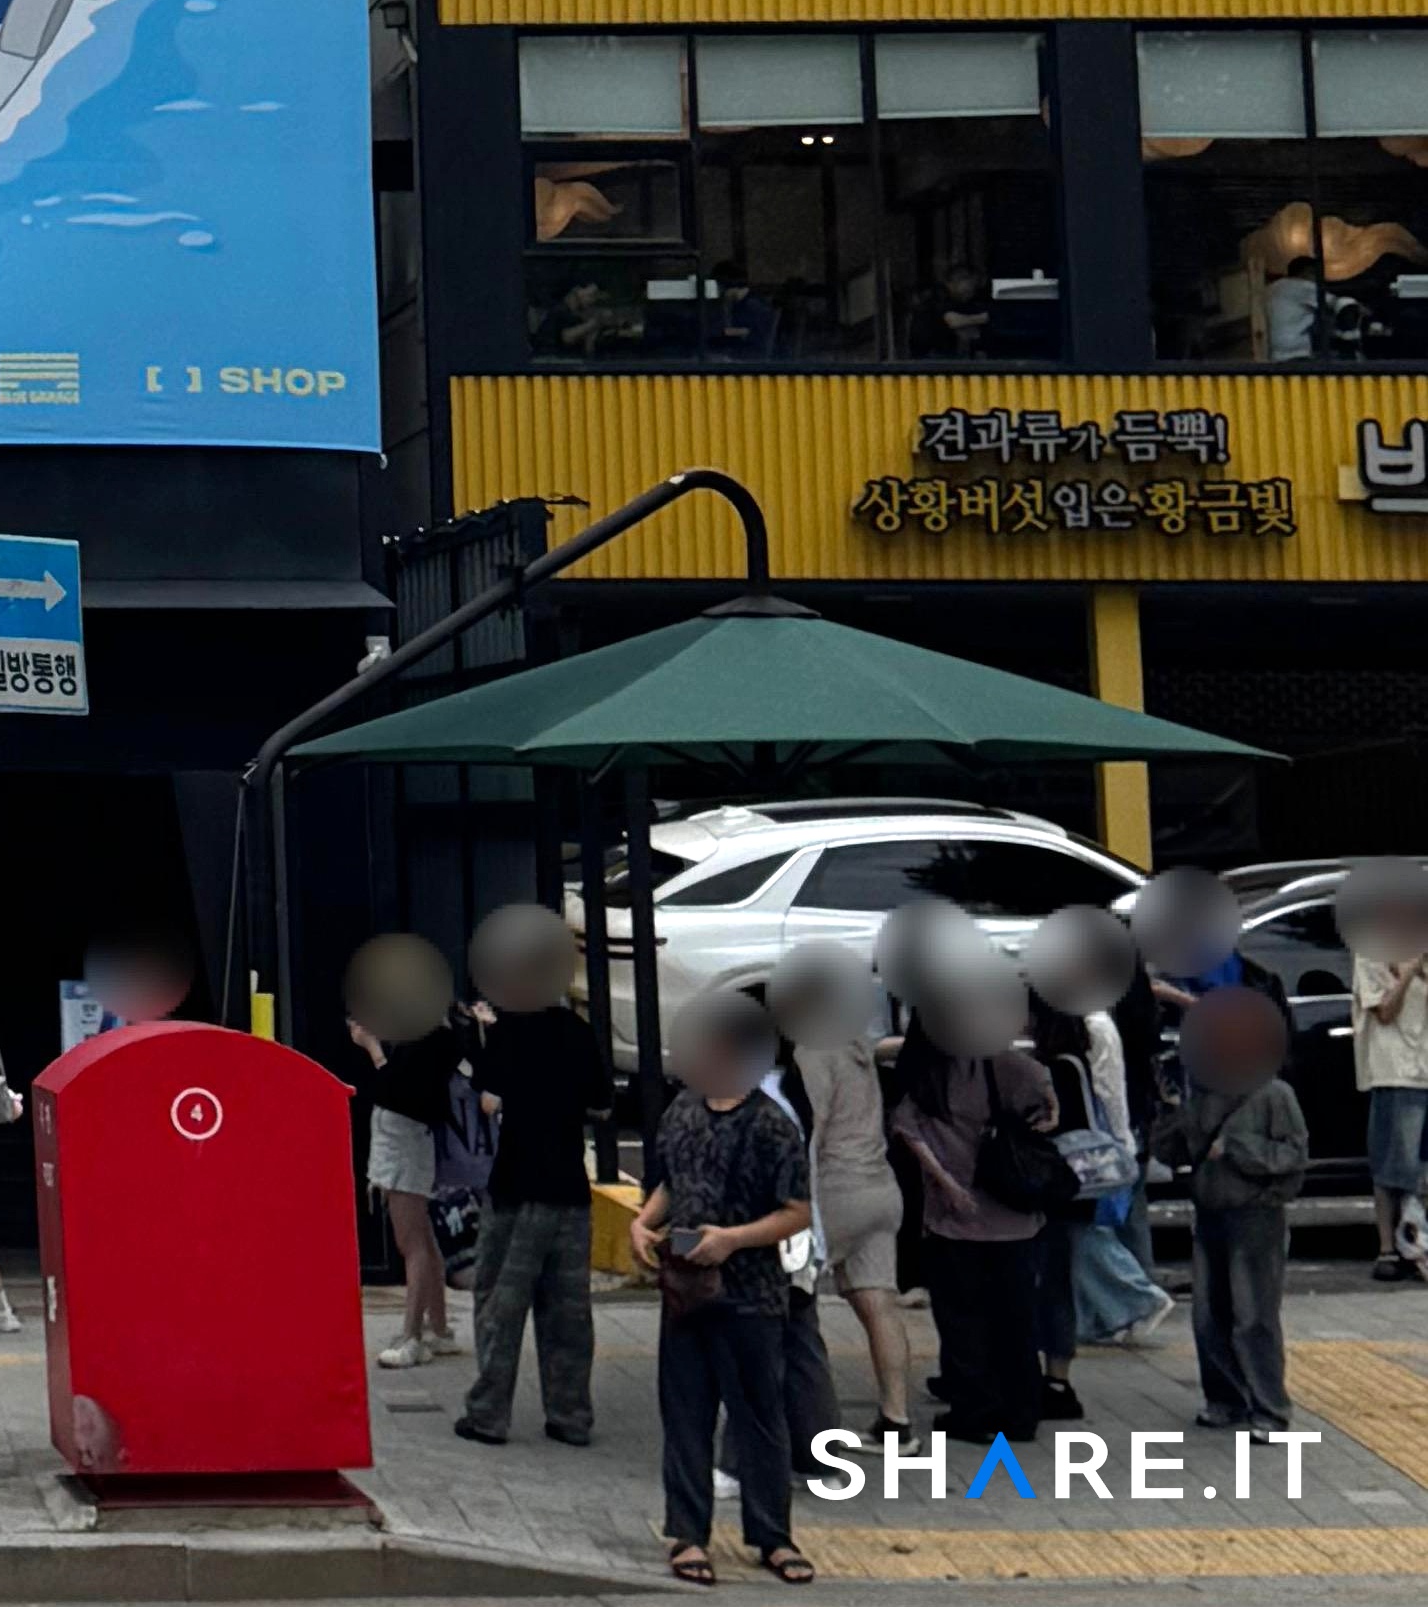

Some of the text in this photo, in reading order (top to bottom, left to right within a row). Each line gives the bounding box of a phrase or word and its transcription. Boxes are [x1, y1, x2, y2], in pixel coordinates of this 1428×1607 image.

[219, 366, 347, 396] SHOP
[924, 410, 1228, 463] 견과류가 듬뿍!
[859, 478, 1294, 534] 상황버섯 입은 황금빛
